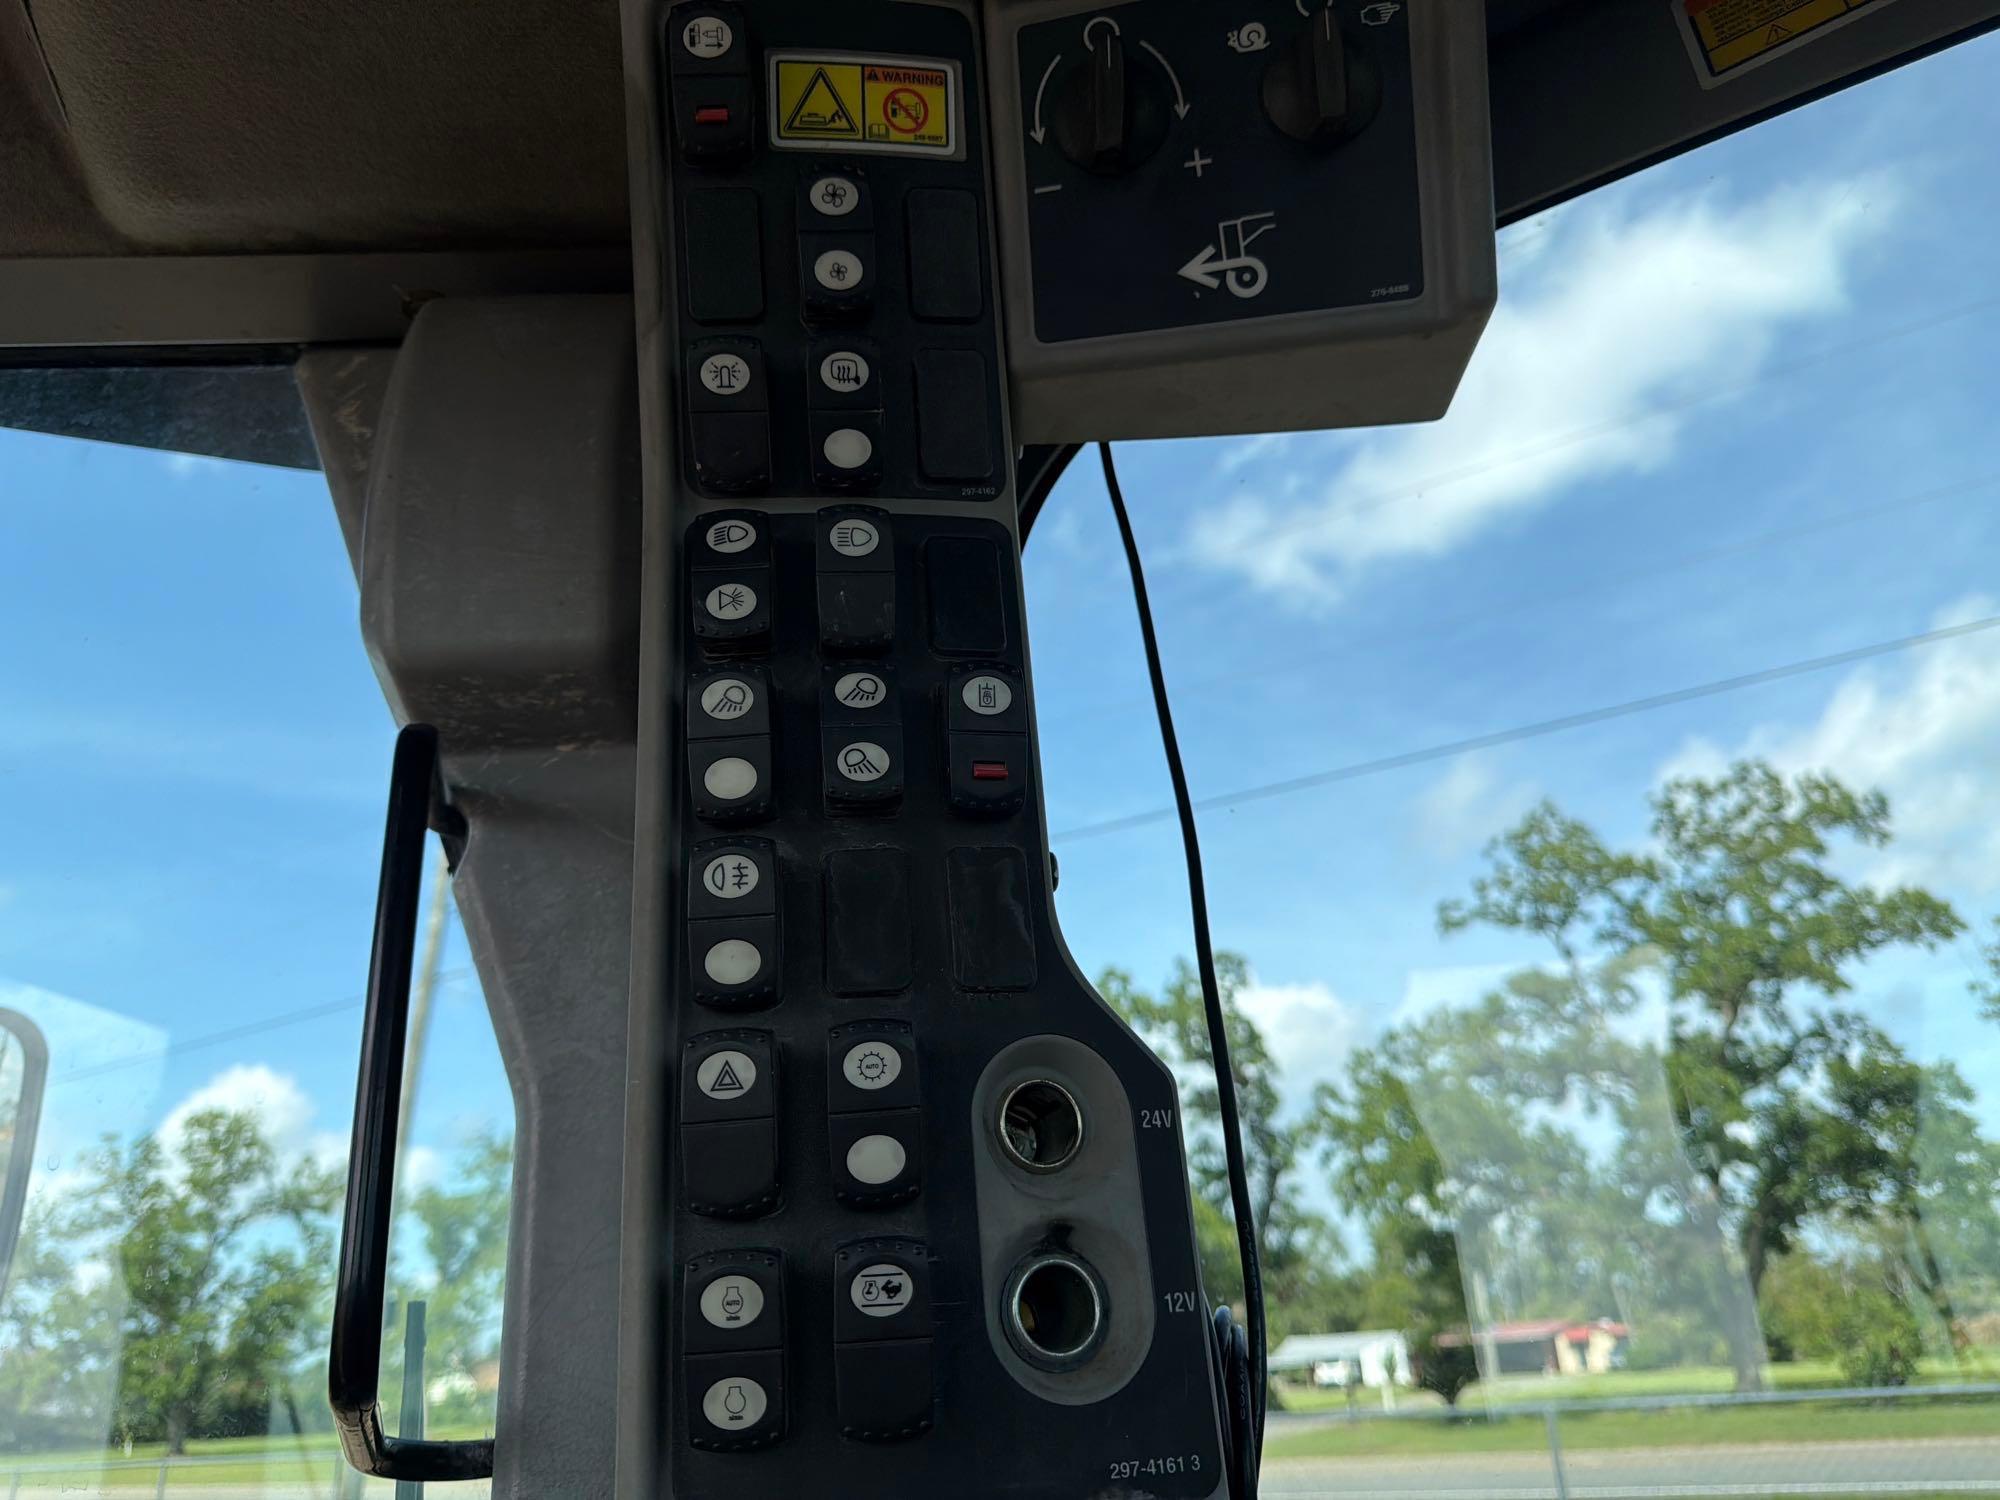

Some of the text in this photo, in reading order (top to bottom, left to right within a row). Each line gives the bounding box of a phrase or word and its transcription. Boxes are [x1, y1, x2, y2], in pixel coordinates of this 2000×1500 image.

[882, 71, 944, 86] WARNING
[1141, 1109, 1172, 1128] 24V
[1164, 1291, 1195, 1313] 12V
[1110, 1454, 1201, 1479] 297-4161 3
